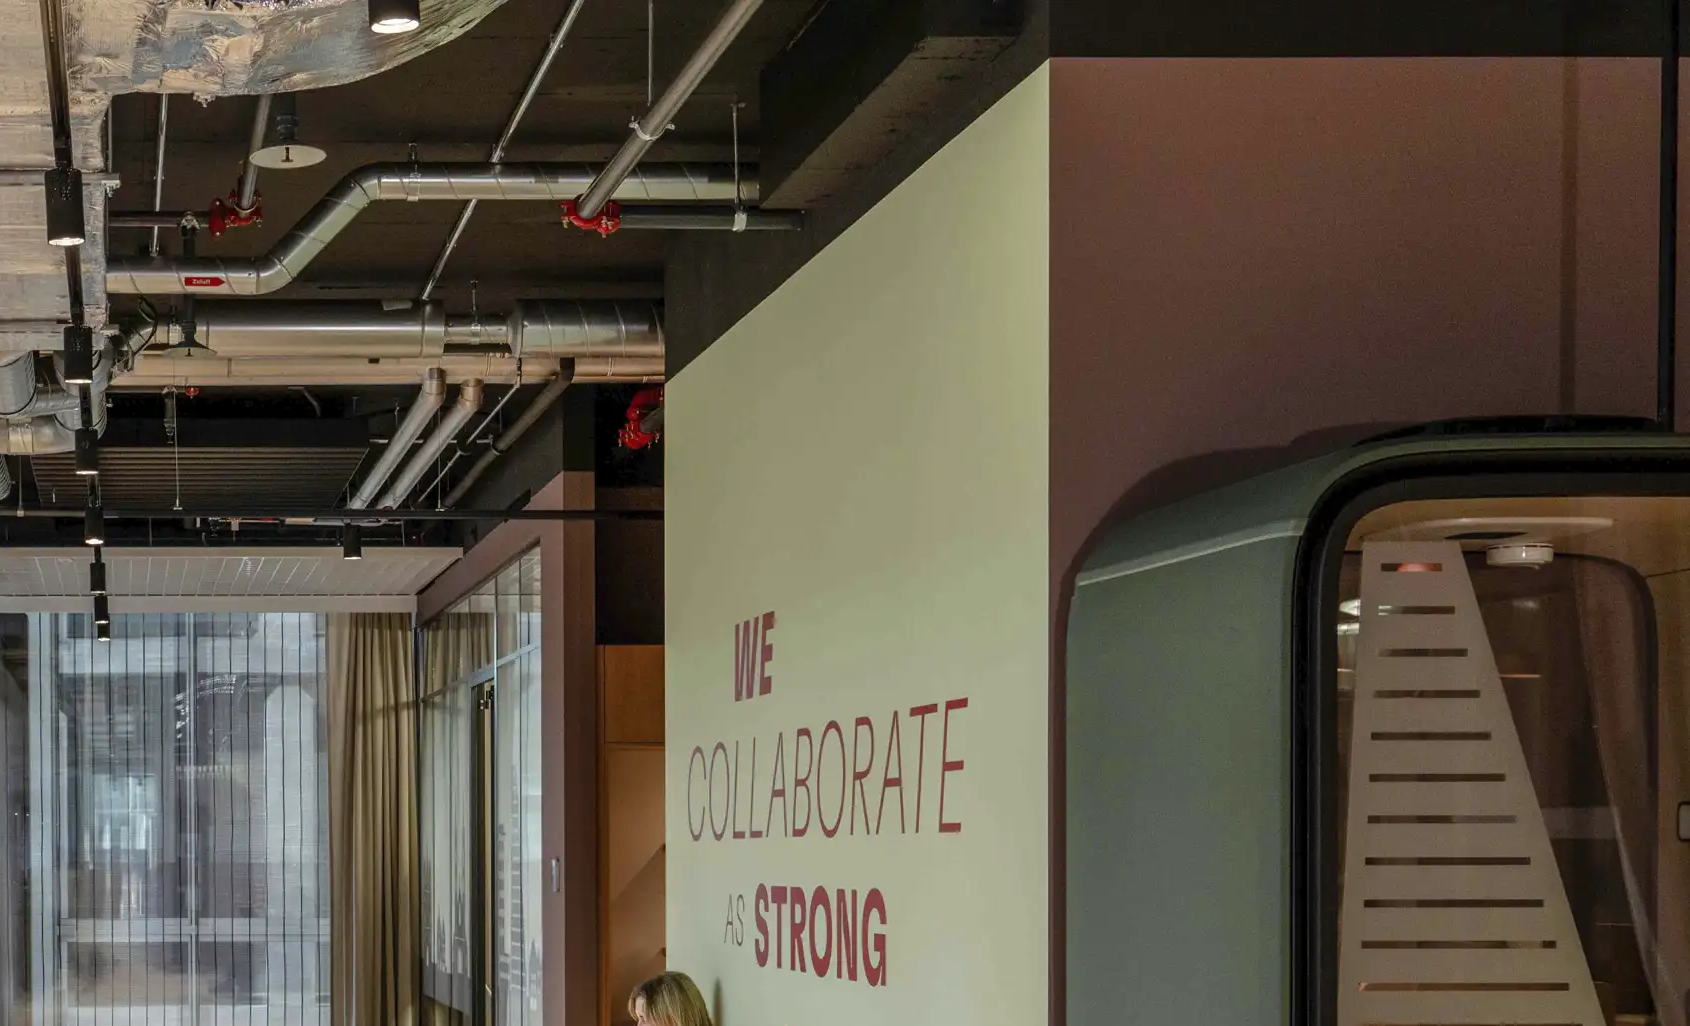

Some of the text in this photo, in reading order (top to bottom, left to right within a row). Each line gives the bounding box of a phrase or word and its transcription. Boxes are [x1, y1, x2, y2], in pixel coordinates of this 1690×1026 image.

[734, 611, 775, 702] WE
[687, 697, 969, 843] COLLABORATE
[723, 882, 887, 987] AS STRONG
